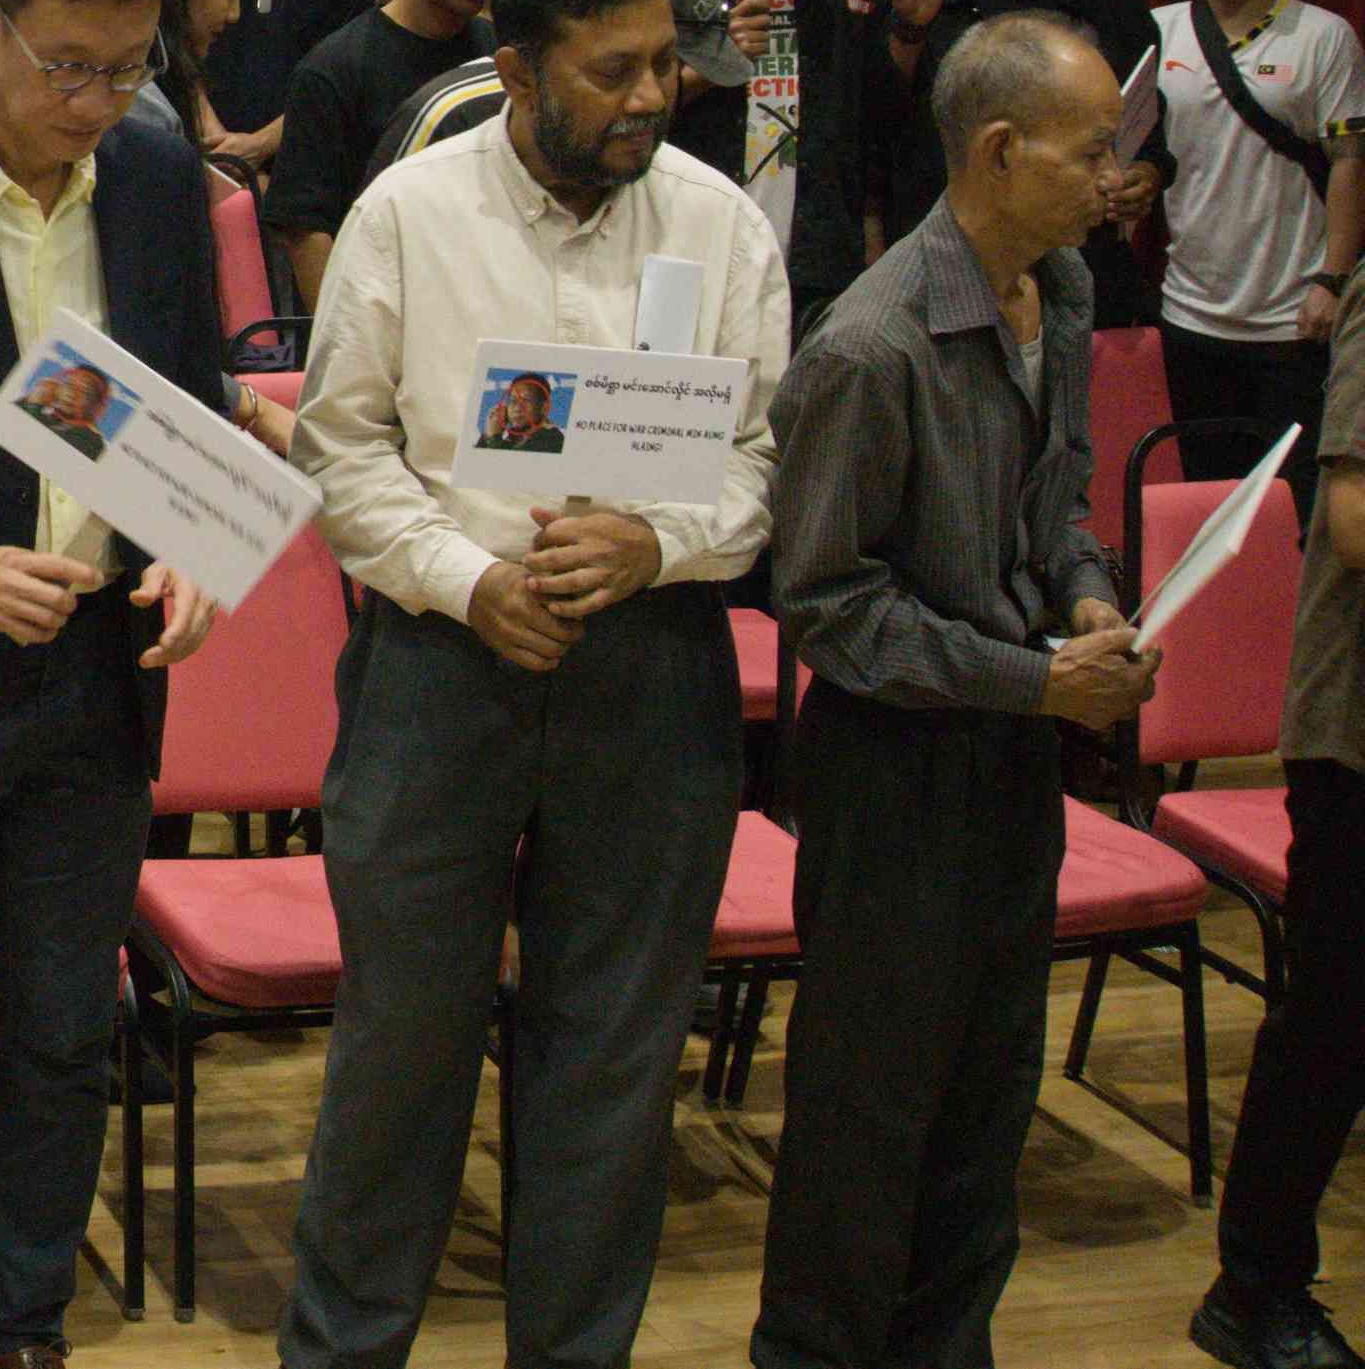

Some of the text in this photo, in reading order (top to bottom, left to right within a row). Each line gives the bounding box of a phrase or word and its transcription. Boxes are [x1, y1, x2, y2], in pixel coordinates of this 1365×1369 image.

[575, 420, 724, 439] NO PLACE FOR WAR CRIMINAL MIN AUNG
